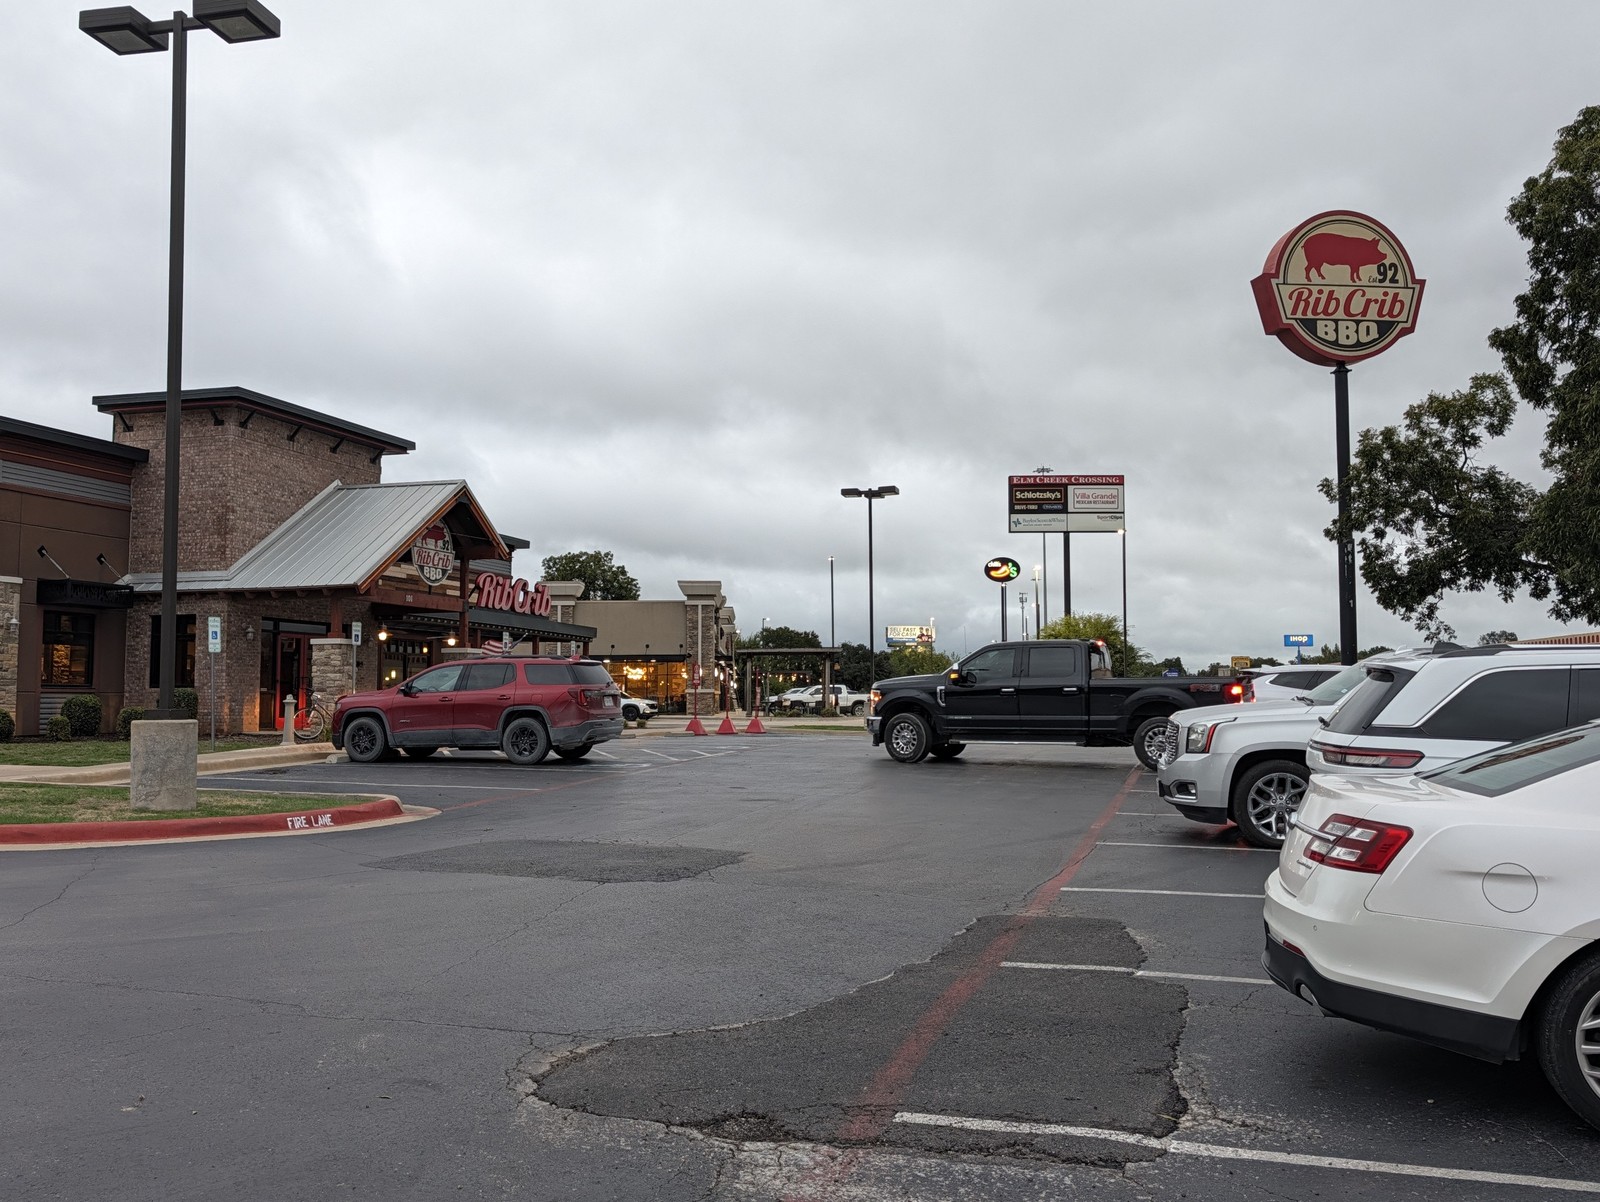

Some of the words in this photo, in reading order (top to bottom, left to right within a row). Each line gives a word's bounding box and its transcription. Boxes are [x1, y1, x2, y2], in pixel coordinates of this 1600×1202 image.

[1377, 262, 1399, 284] 92
[1316, 320, 1379, 345] BBQ
[1013, 476, 1034, 484] ELM
[1036, 476, 1069, 484] CREEK
[1071, 476, 1119, 484] CROSSING
[1015, 491, 1061, 500] Schlotzsky's
[287, 816, 309, 829] FIRE
[311, 814, 334, 827] LANE
